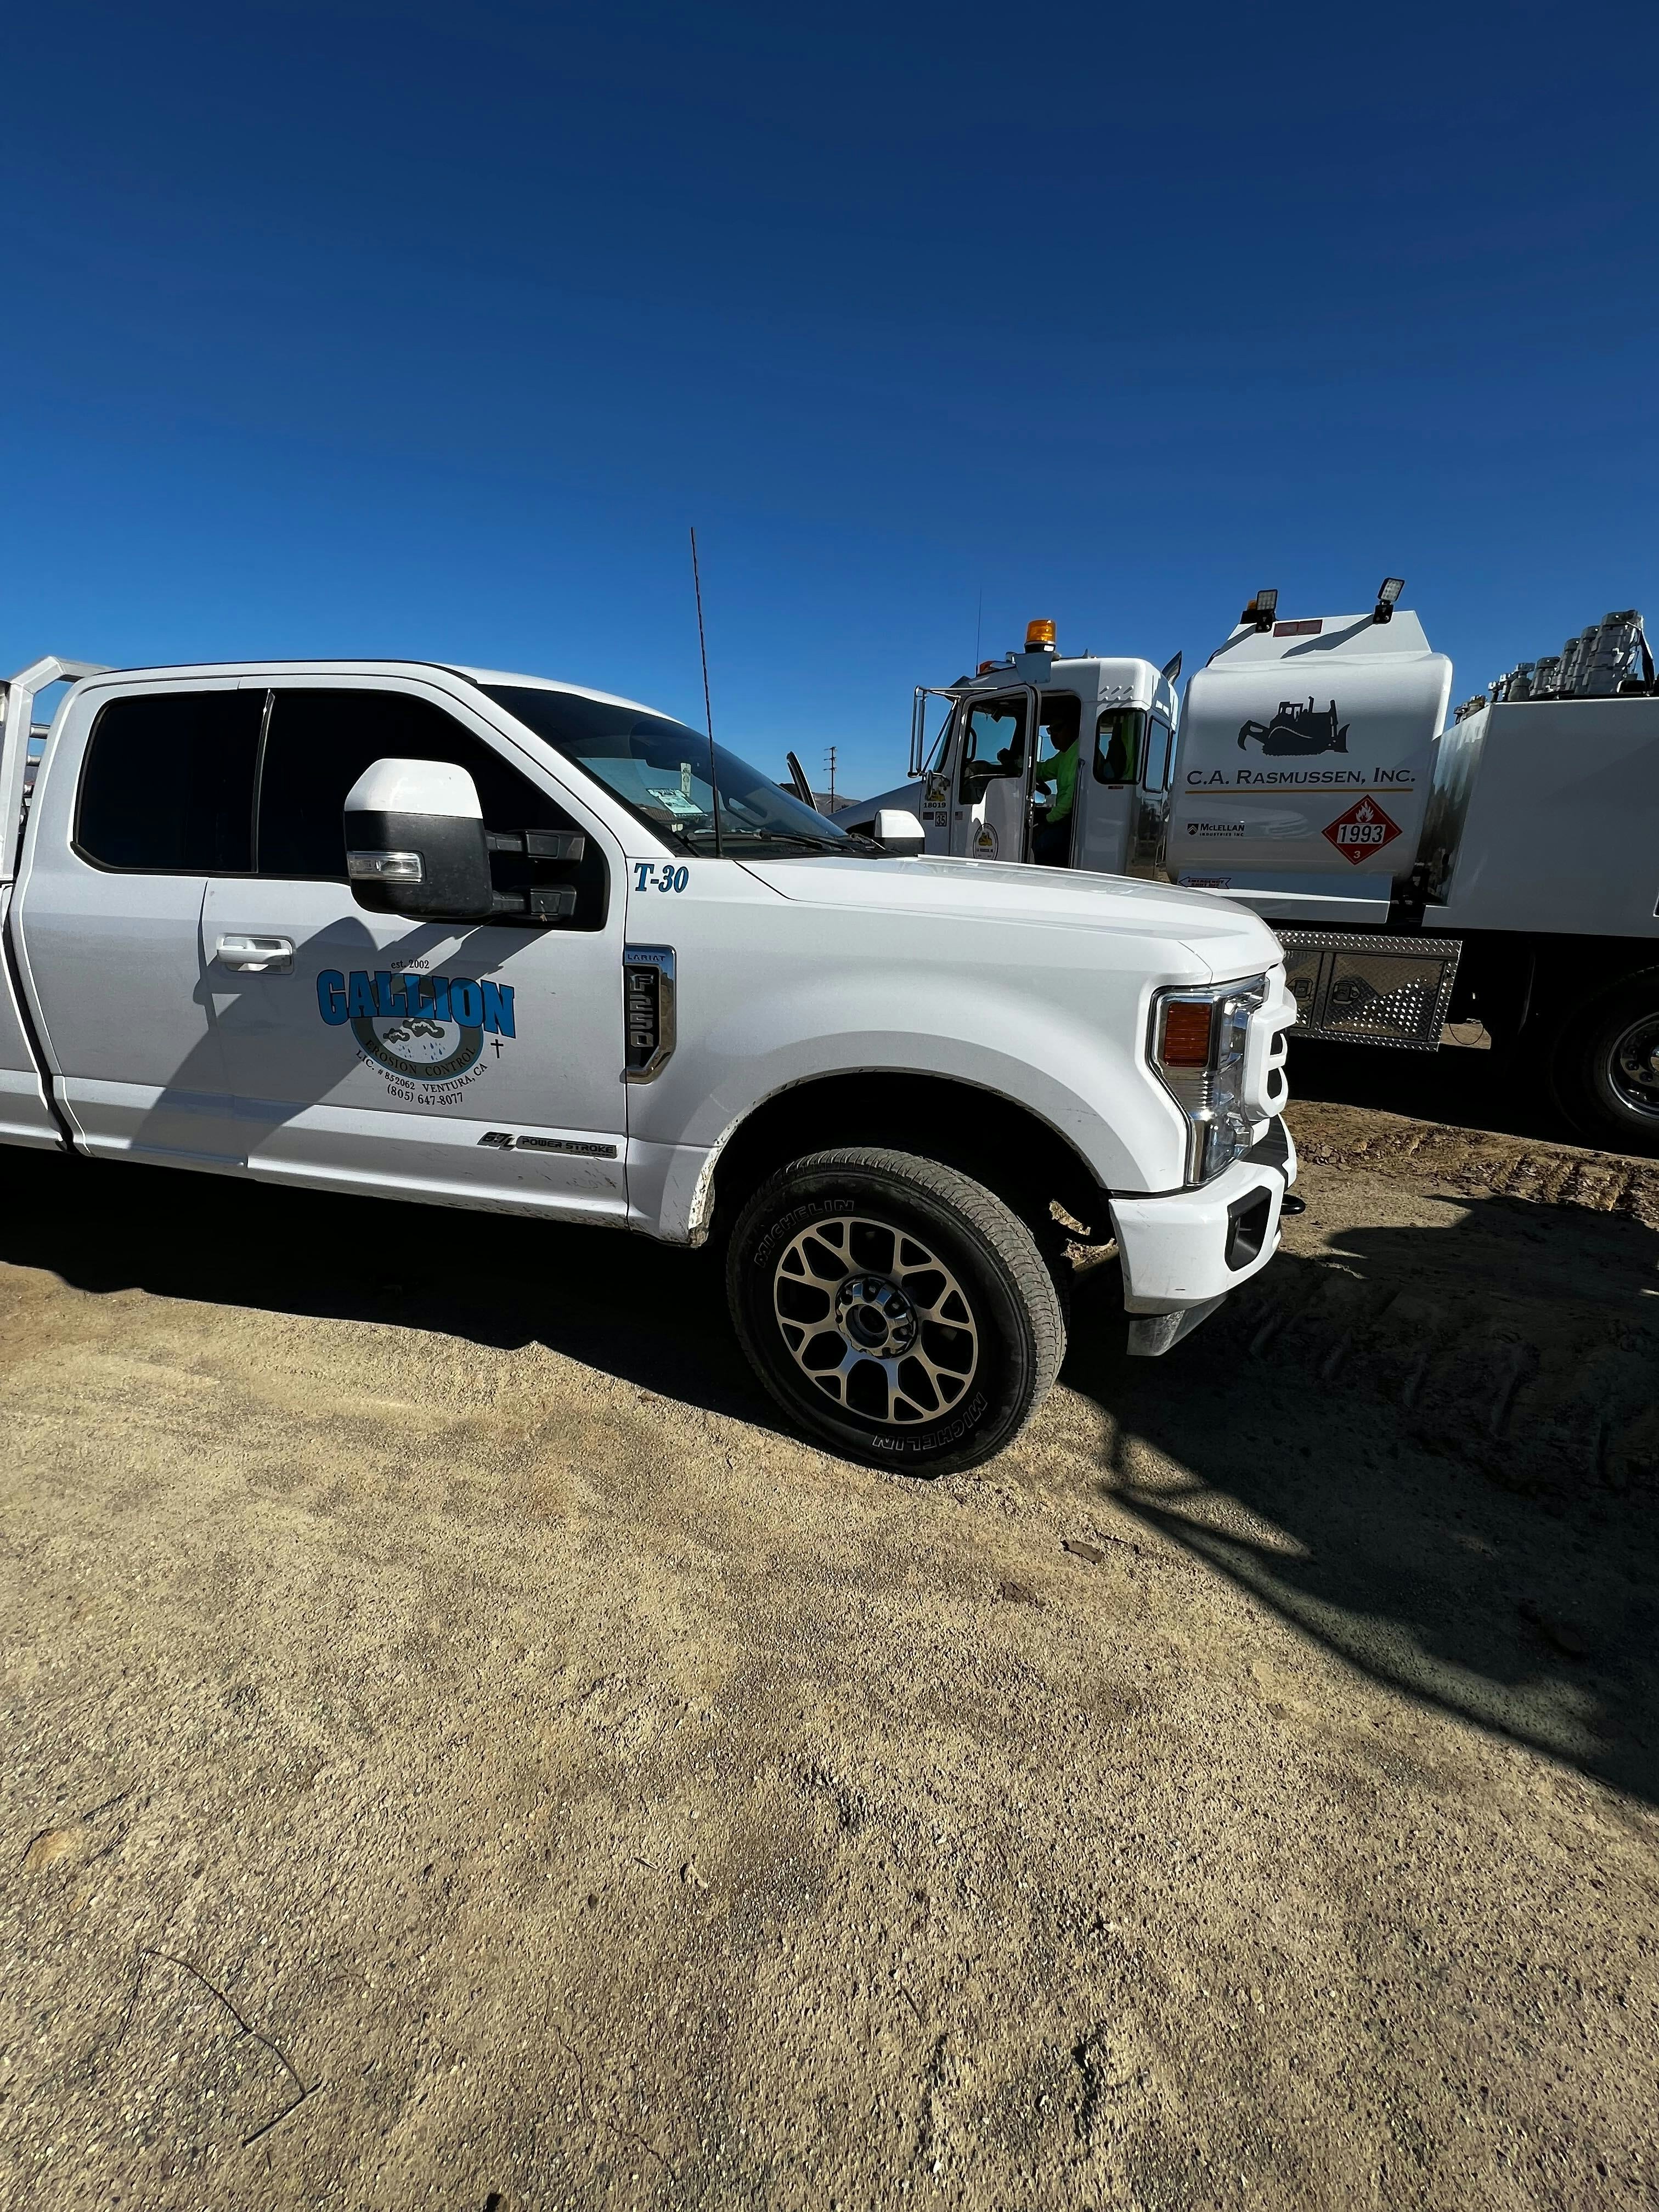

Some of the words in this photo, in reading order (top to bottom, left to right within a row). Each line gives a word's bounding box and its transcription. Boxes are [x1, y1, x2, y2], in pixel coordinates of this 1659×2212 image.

[1187, 770, 1229, 785] C.A.
[1237, 769, 1365, 785] RASMUSSEN,
[1374, 768, 1416, 783] INC.
[936, 815, 945, 825] 35
[1339, 824, 1384, 844] 1993
[1353, 850, 1361, 859] 3
[634, 862, 689, 893] T-30
[391, 960, 407, 969] est.
[409, 960, 430, 969] 2002
[627, 953, 665, 962] LARIAT
[316, 969, 516, 1039] GALLION
[365, 1040, 416, 1075] EROSION
[425, 1047, 476, 1077] CONTROL
[356, 1049, 375, 1070] LIC.
[385, 1071, 415, 1090] 852062
[422, 1075, 476, 1093] VENTURA,
[473, 1063, 488, 1077] CA
[387, 1084, 414, 1102] (805)
[417, 1092, 464, 1106] 647-8077
[522, 1138, 562, 1148] POWER
[566, 1143, 613, 1154] STROKE
[754, 1199, 854, 1268] MICHELIN
[872, 1392, 988, 1452] MICHELIN
